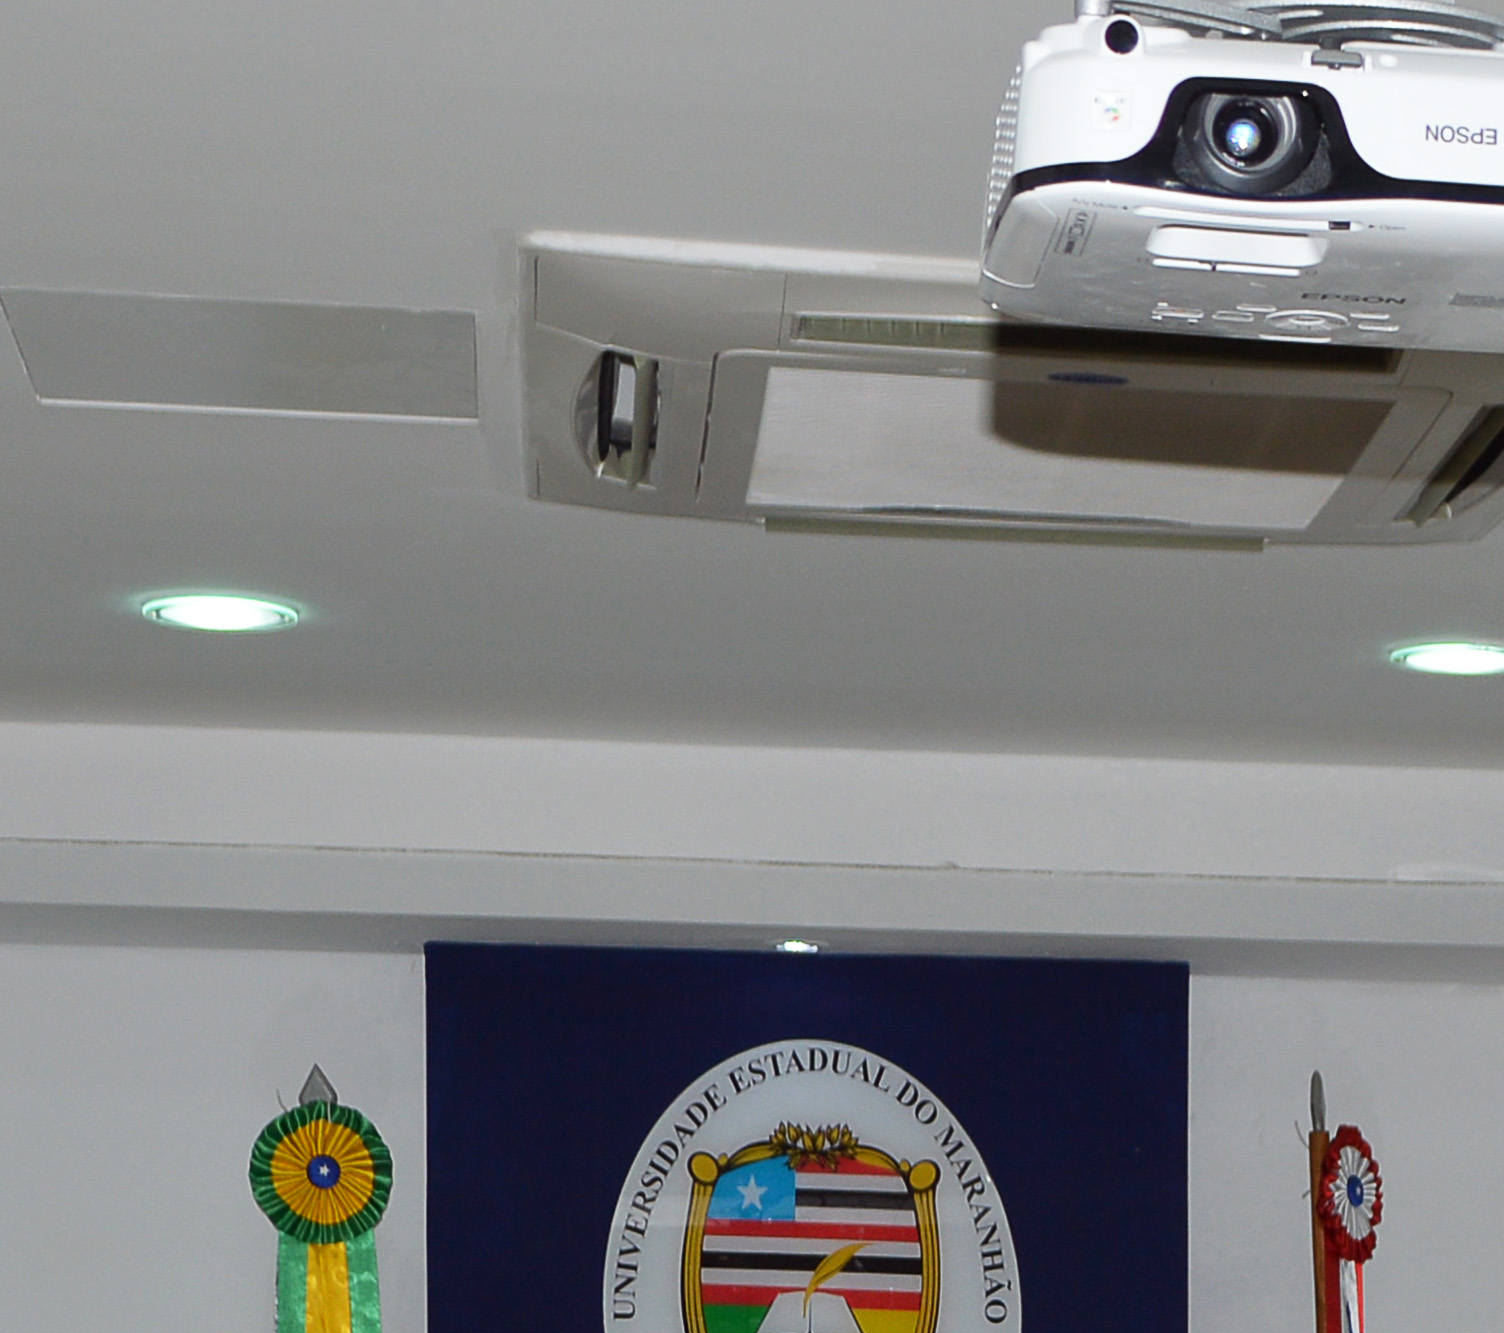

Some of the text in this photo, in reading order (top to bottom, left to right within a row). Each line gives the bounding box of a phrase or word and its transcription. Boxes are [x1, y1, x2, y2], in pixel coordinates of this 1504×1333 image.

[1425, 125, 1497, 145] EPSON
[1301, 292, 1406, 305] EPSON
[613, 1047, 1012, 1324] UNIVERSIDADE ESTADUAL DO MARANHÃO
